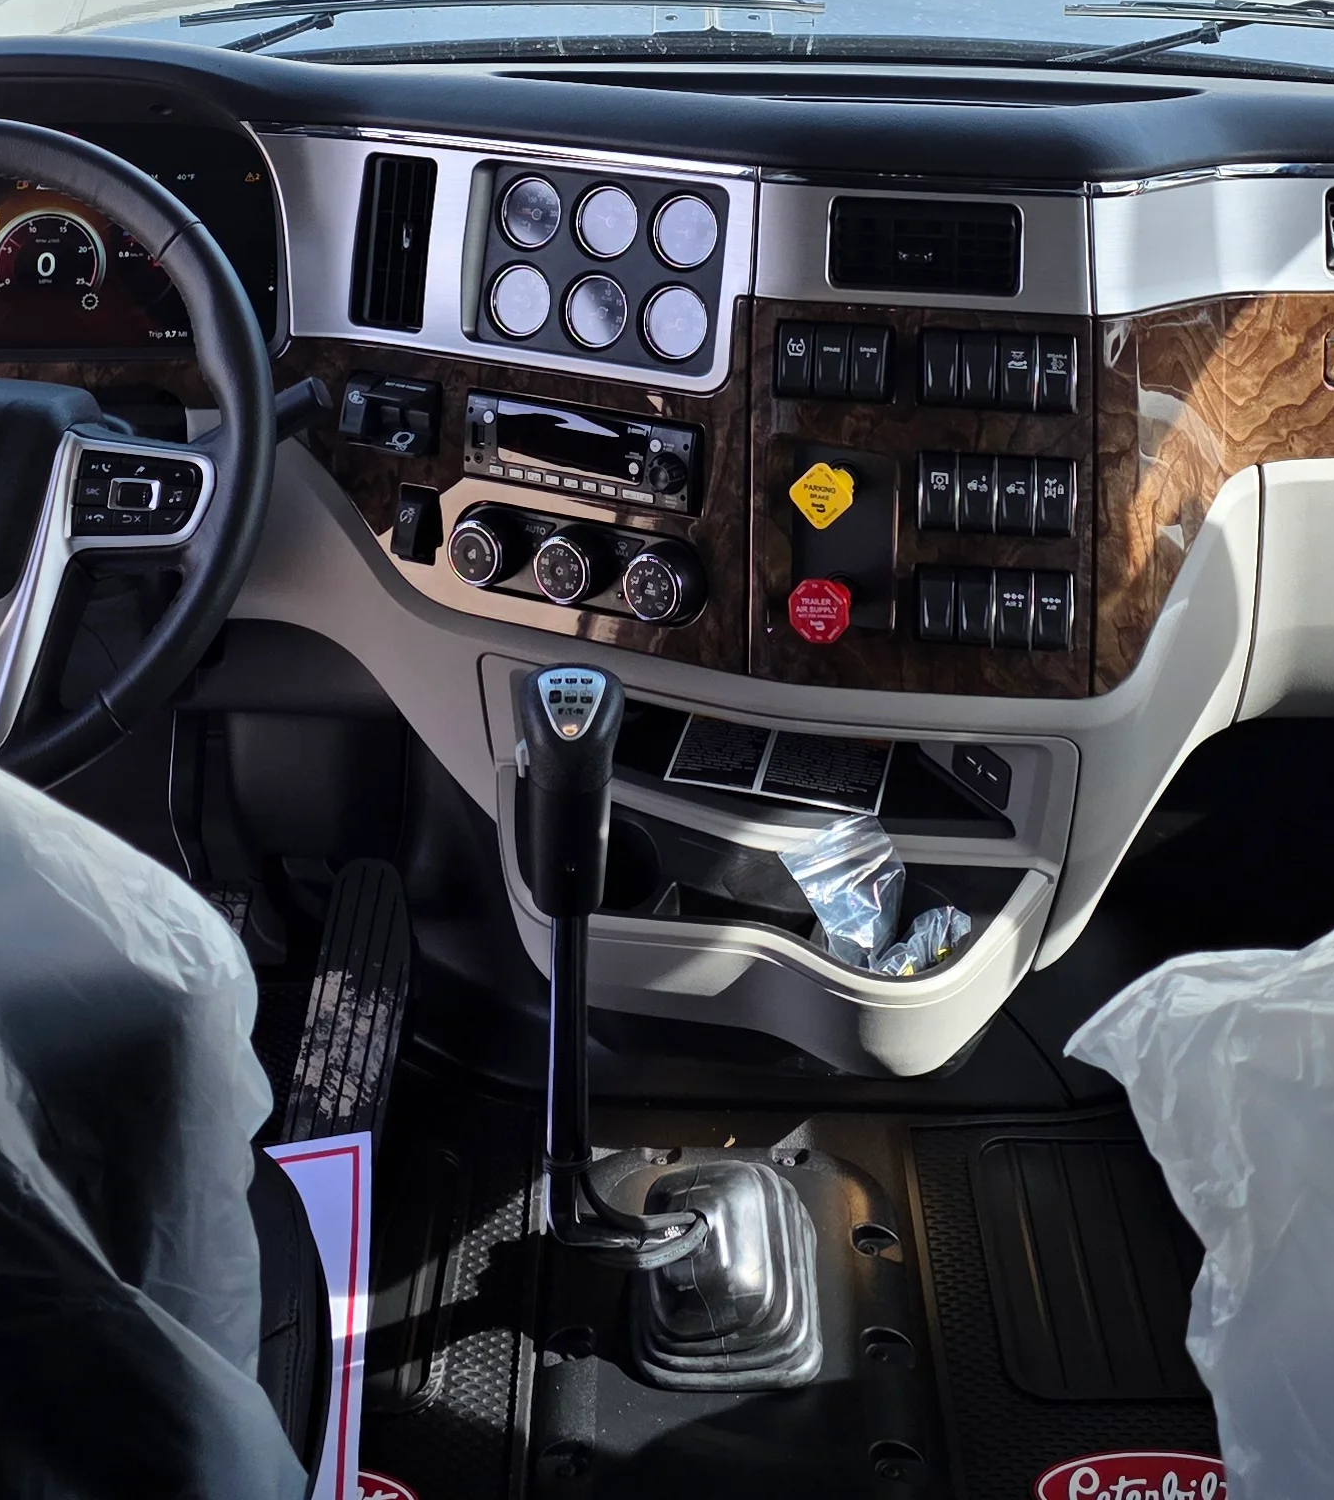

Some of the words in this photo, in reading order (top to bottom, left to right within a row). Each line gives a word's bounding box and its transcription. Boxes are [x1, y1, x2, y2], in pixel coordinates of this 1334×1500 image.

[37, 252, 56, 277] 0
[75, 277, 85, 285] 25
[148, 330, 163, 339] Trip
[164, 330, 176, 338] 9.7
[790, 343, 803, 352] TC
[85, 487, 101, 496] SRC
[803, 483, 836, 494] PARKING
[809, 493, 830, 501] BRAKE
[524, 523, 546, 536] AUTO
[800, 597, 832, 606] TRAILER
[795, 605, 808, 613] AIR
[808, 605, 838, 614] SUPPLY
